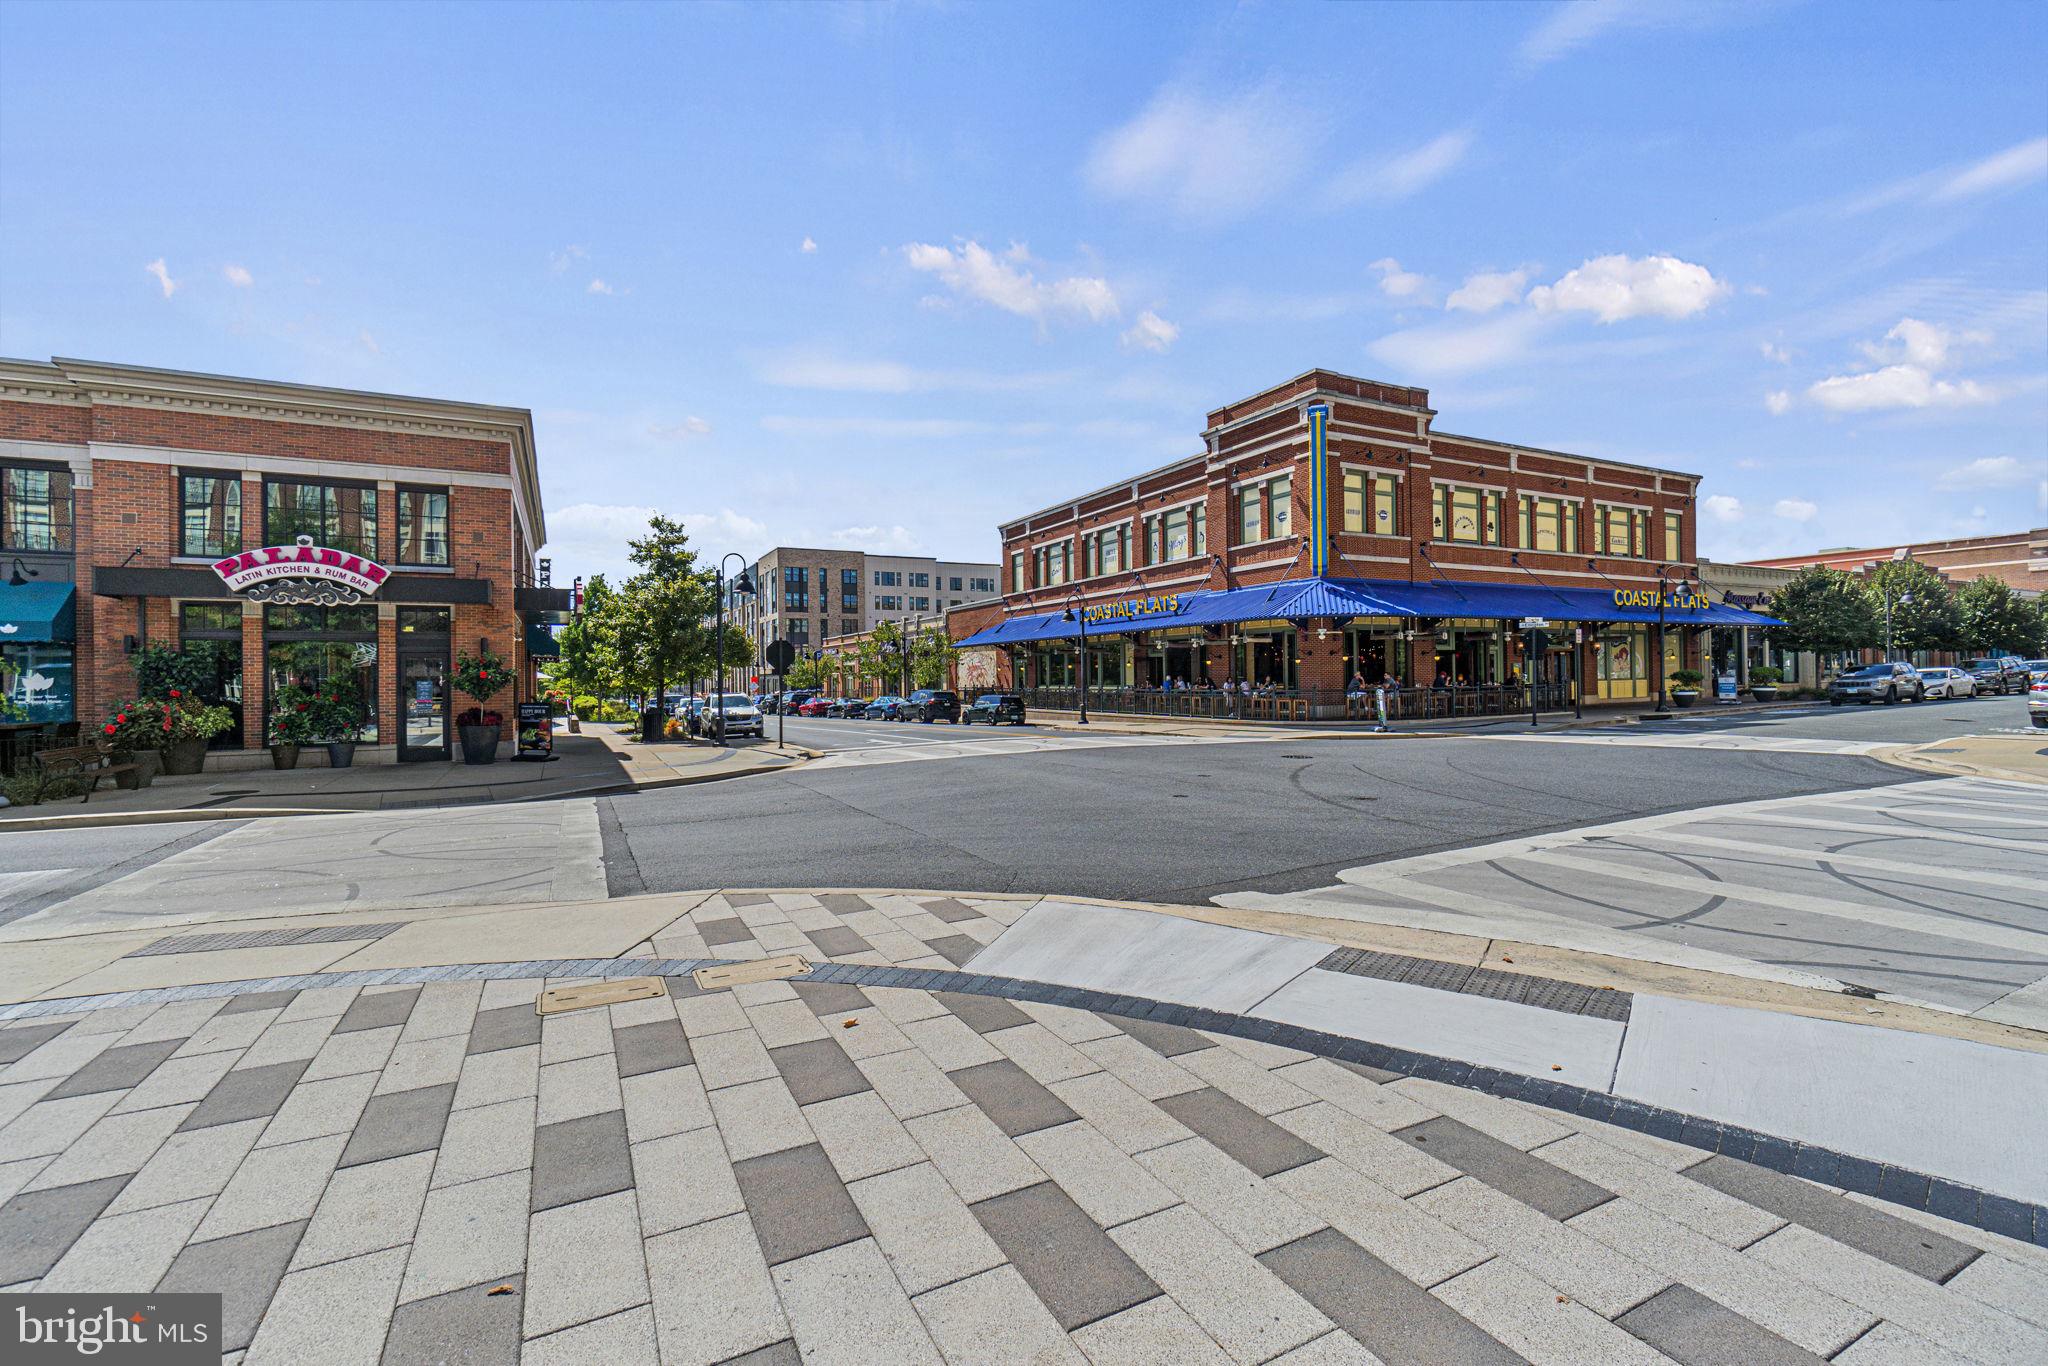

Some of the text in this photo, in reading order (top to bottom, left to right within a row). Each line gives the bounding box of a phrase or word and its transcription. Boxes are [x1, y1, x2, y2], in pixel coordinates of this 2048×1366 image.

[214, 546, 388, 585] PALADAR
[235, 570, 263, 585] LATIN
[266, 565, 310, 575] KITCHEN
[325, 568, 347, 580] RUM
[350, 576, 369, 588] BAR
[1083, 593, 1179, 621] COASTAL FLATS
[1615, 589, 1710, 609] COASTAL FLATS
